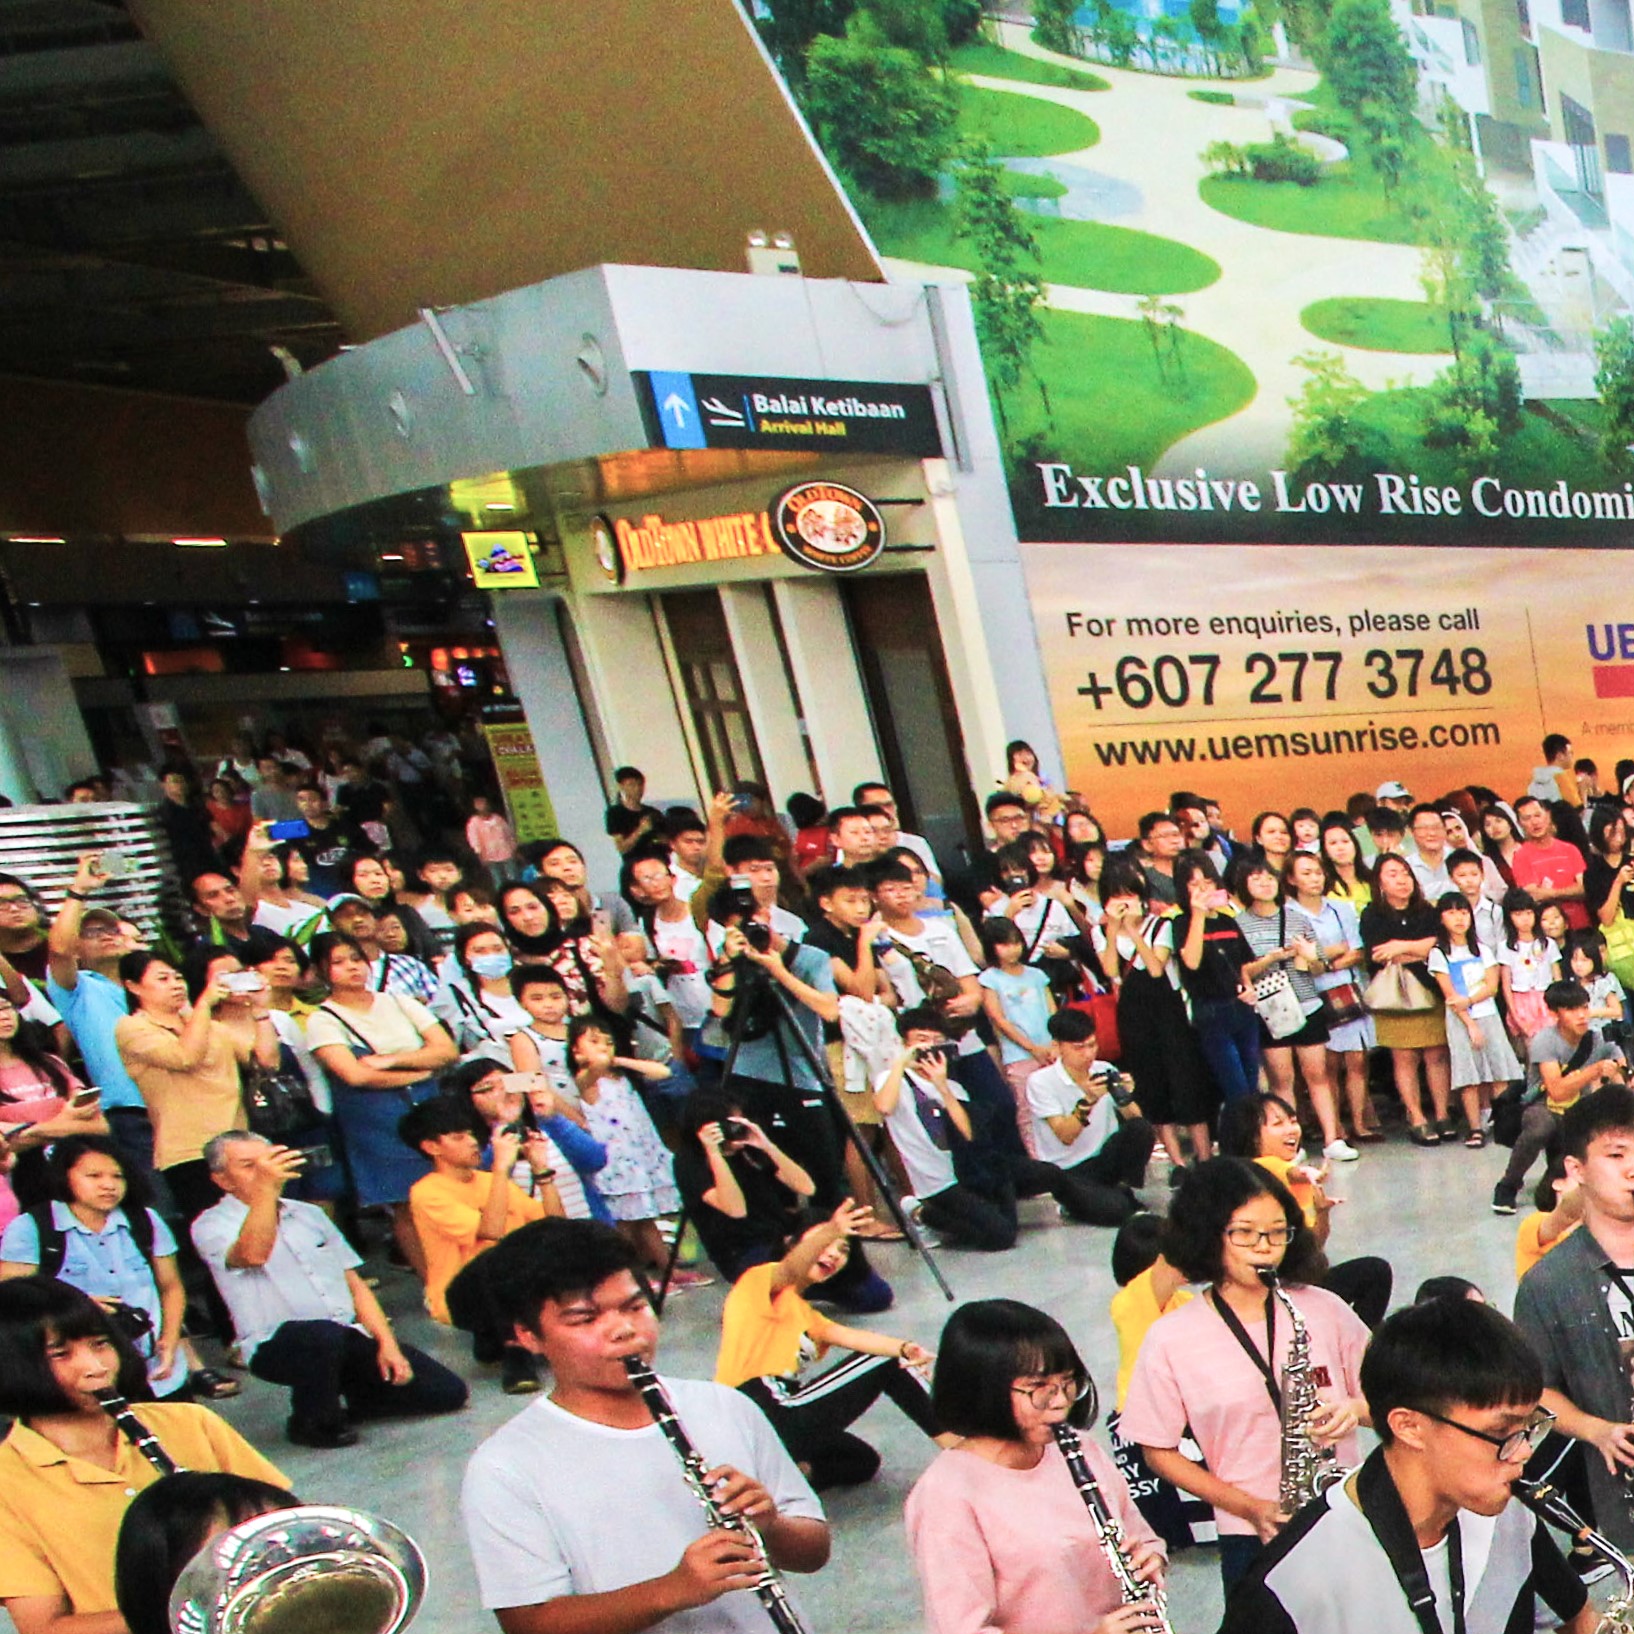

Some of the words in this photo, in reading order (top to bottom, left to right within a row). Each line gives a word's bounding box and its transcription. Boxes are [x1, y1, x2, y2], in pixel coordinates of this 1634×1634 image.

[752, 393, 808, 416] Balai
[810, 397, 906, 419] Ketibaan
[759, 420, 813, 436] Arrival
[814, 421, 847, 436] Hall
[1036, 463, 1261, 512] Exclusive
[1271, 470, 1364, 514] Low
[1374, 473, 1462, 516] Rise
[698, 512, 764, 561] WHITE
[1065, 612, 1118, 638] For
[1127, 614, 1200, 637] more
[1209, 610, 1342, 640] enquiries,
[1349, 609, 1431, 638] please
[1438, 608, 1480, 631] call
[1076, 653, 1222, 711] +607
[1244, 651, 1343, 704] 277
[1364, 646, 1493, 699] 3748
[1093, 720, 1500, 767] www.uemsunrise.com
